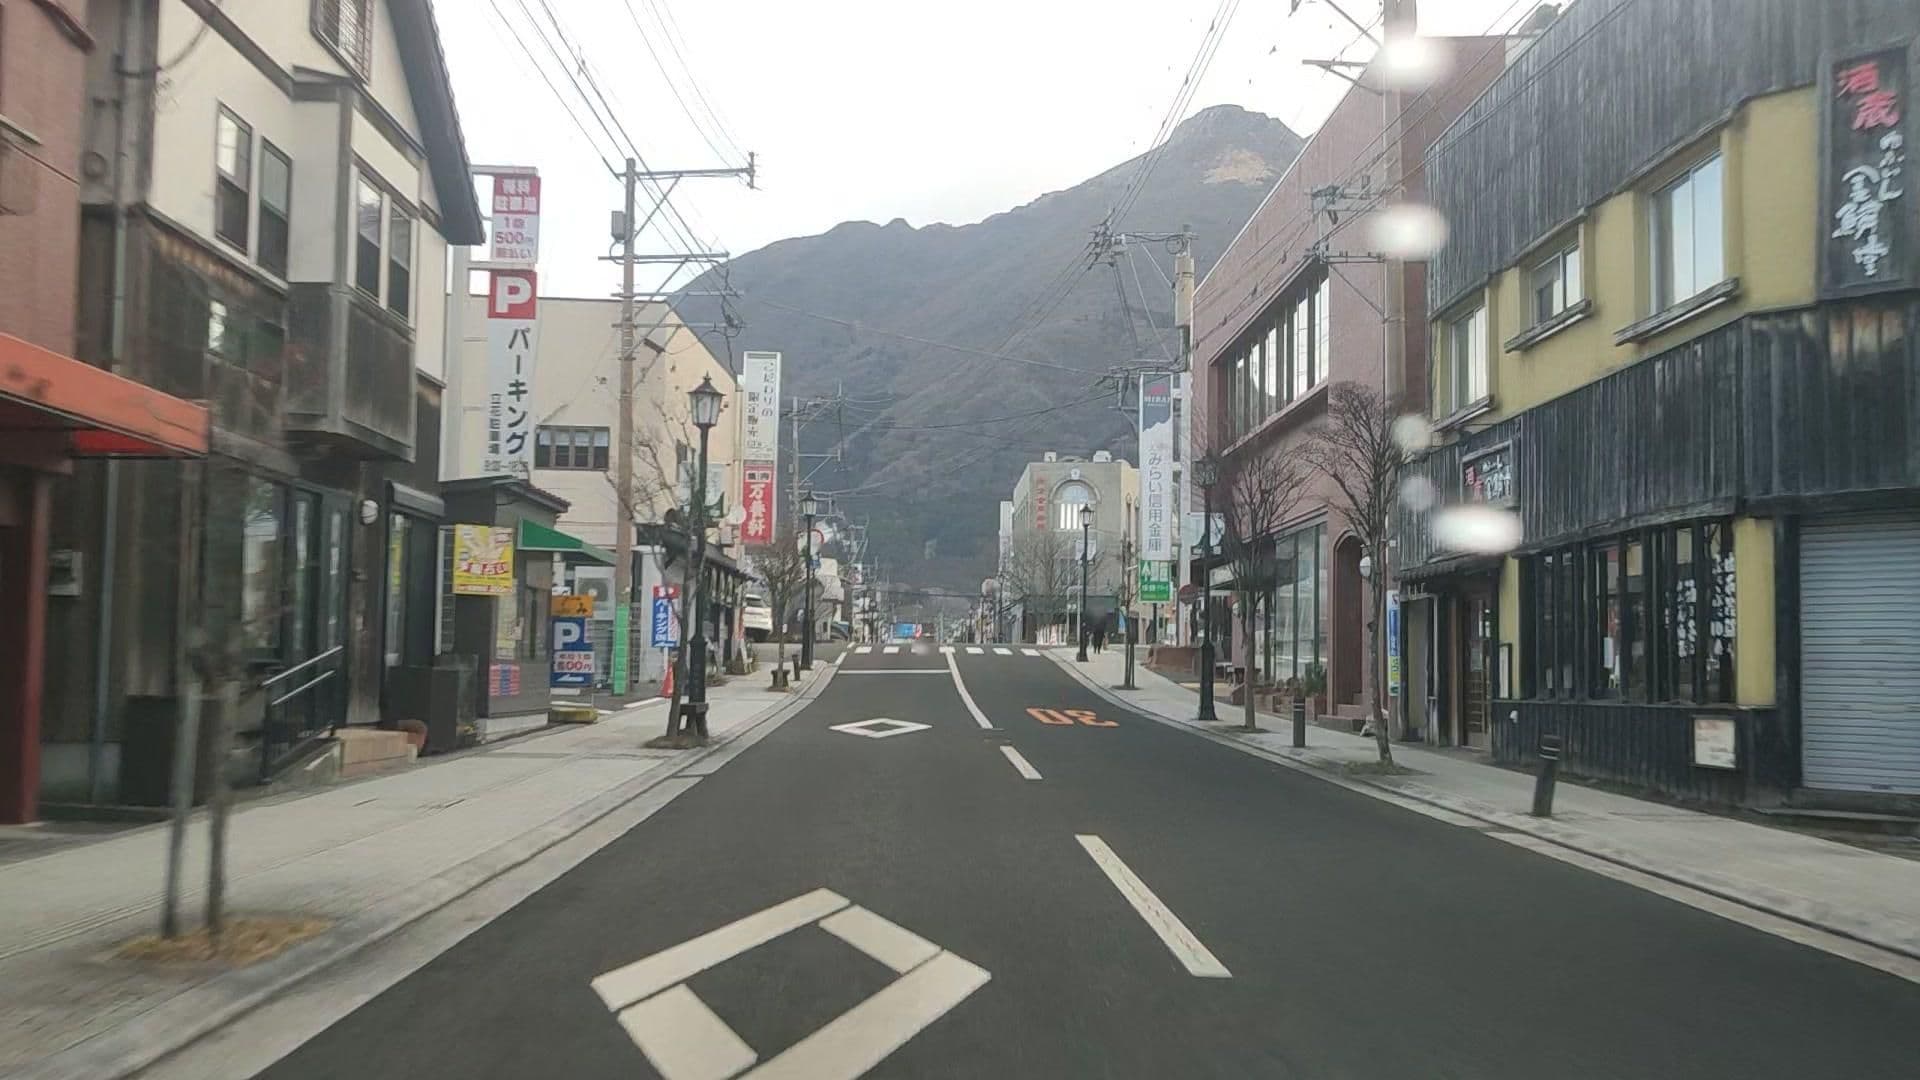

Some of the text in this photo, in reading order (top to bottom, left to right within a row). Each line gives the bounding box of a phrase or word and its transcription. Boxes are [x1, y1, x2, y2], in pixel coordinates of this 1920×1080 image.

[1837, 61, 1900, 130] 酒蔵
[495, 276, 532, 313] P
[506, 327, 530, 455] パーキング
[1147, 452, 1163, 553] みらい信用金庫
[554, 622, 581, 650] P
[1026, 707, 1120, 728] 30
